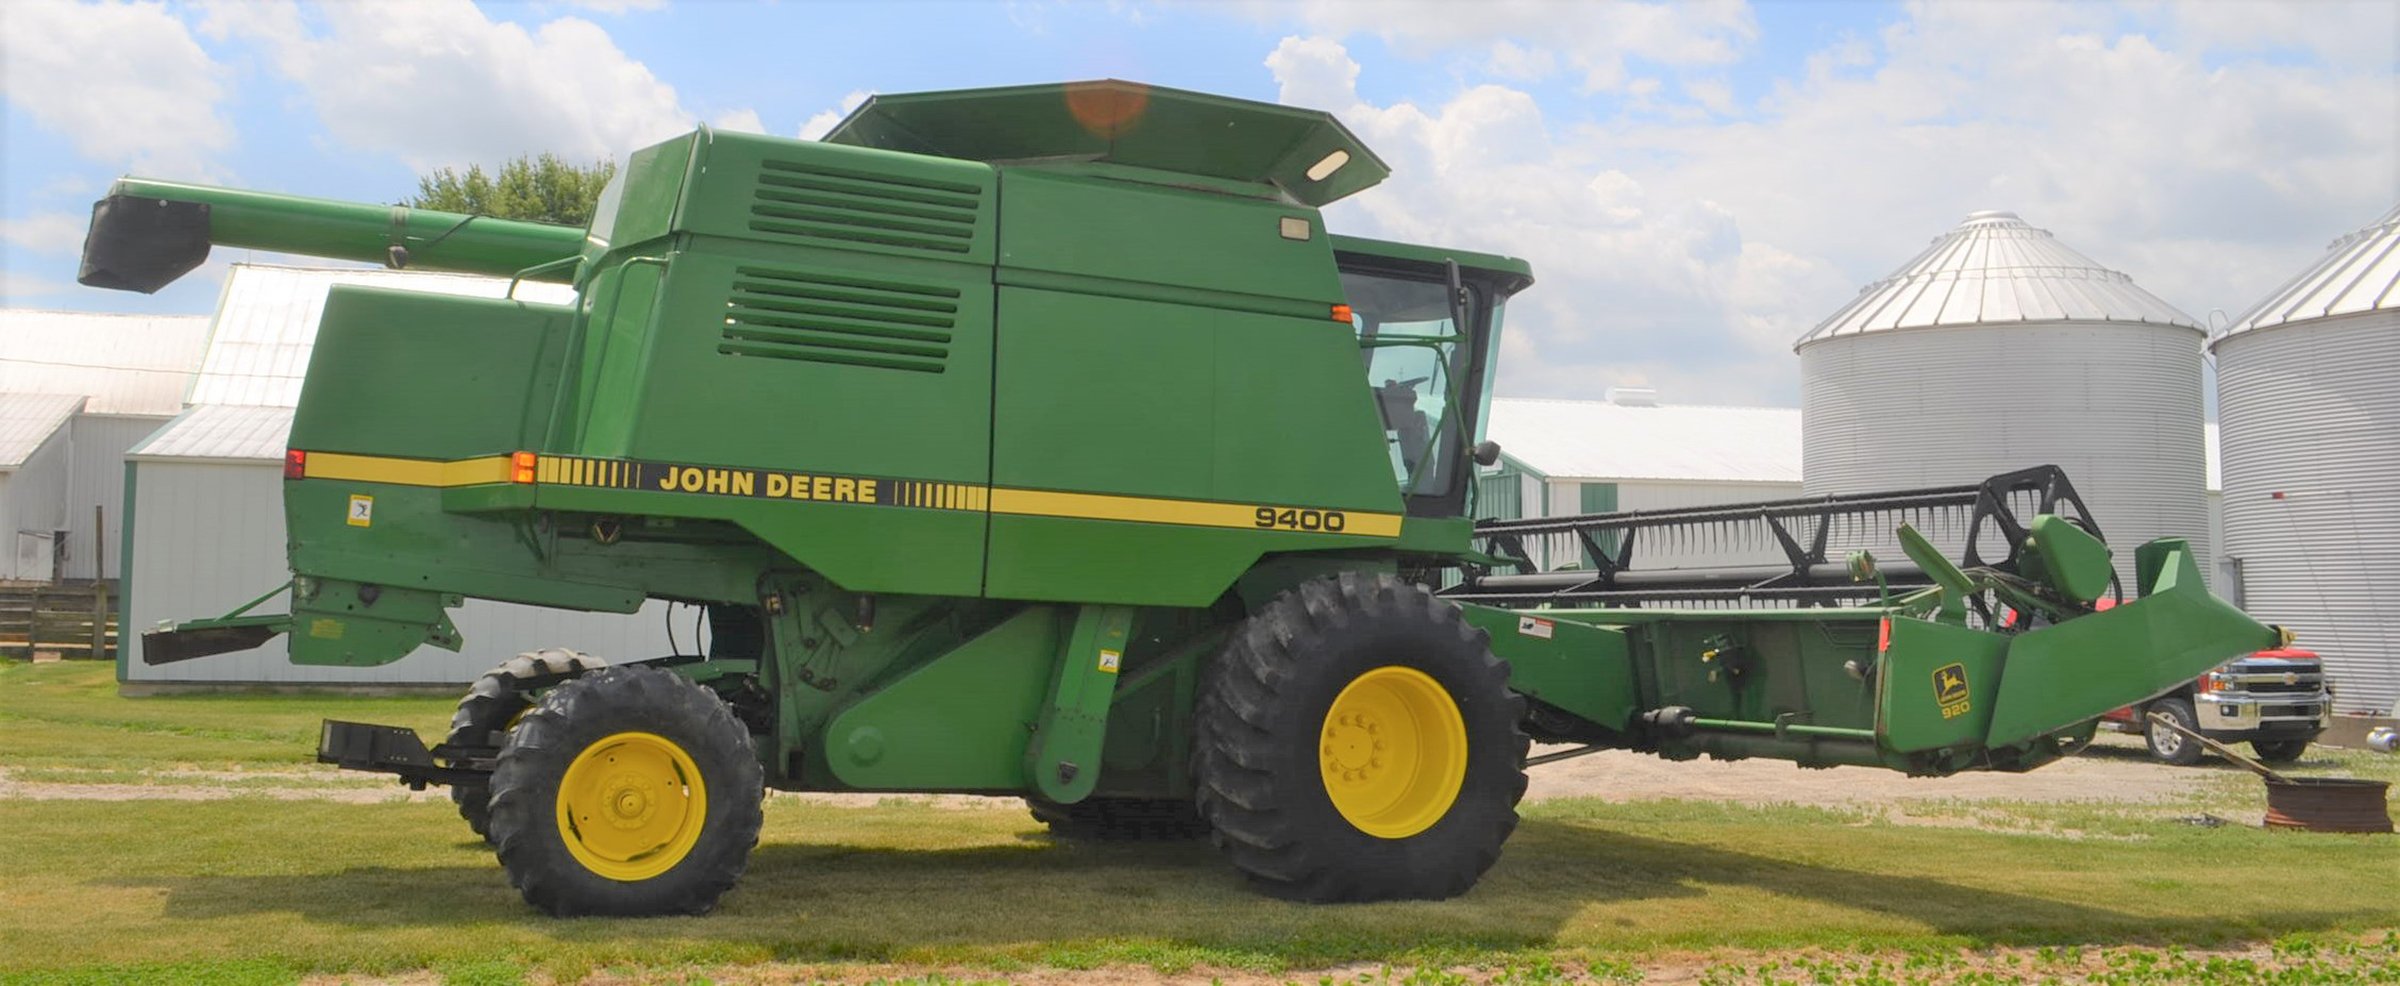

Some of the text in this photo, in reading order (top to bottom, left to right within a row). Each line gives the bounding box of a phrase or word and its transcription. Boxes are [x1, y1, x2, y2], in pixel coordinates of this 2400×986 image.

[659, 466, 877, 503] JOHN DEERE
[1255, 507, 1345, 532] 9400
[1941, 701, 1970, 719] 920
